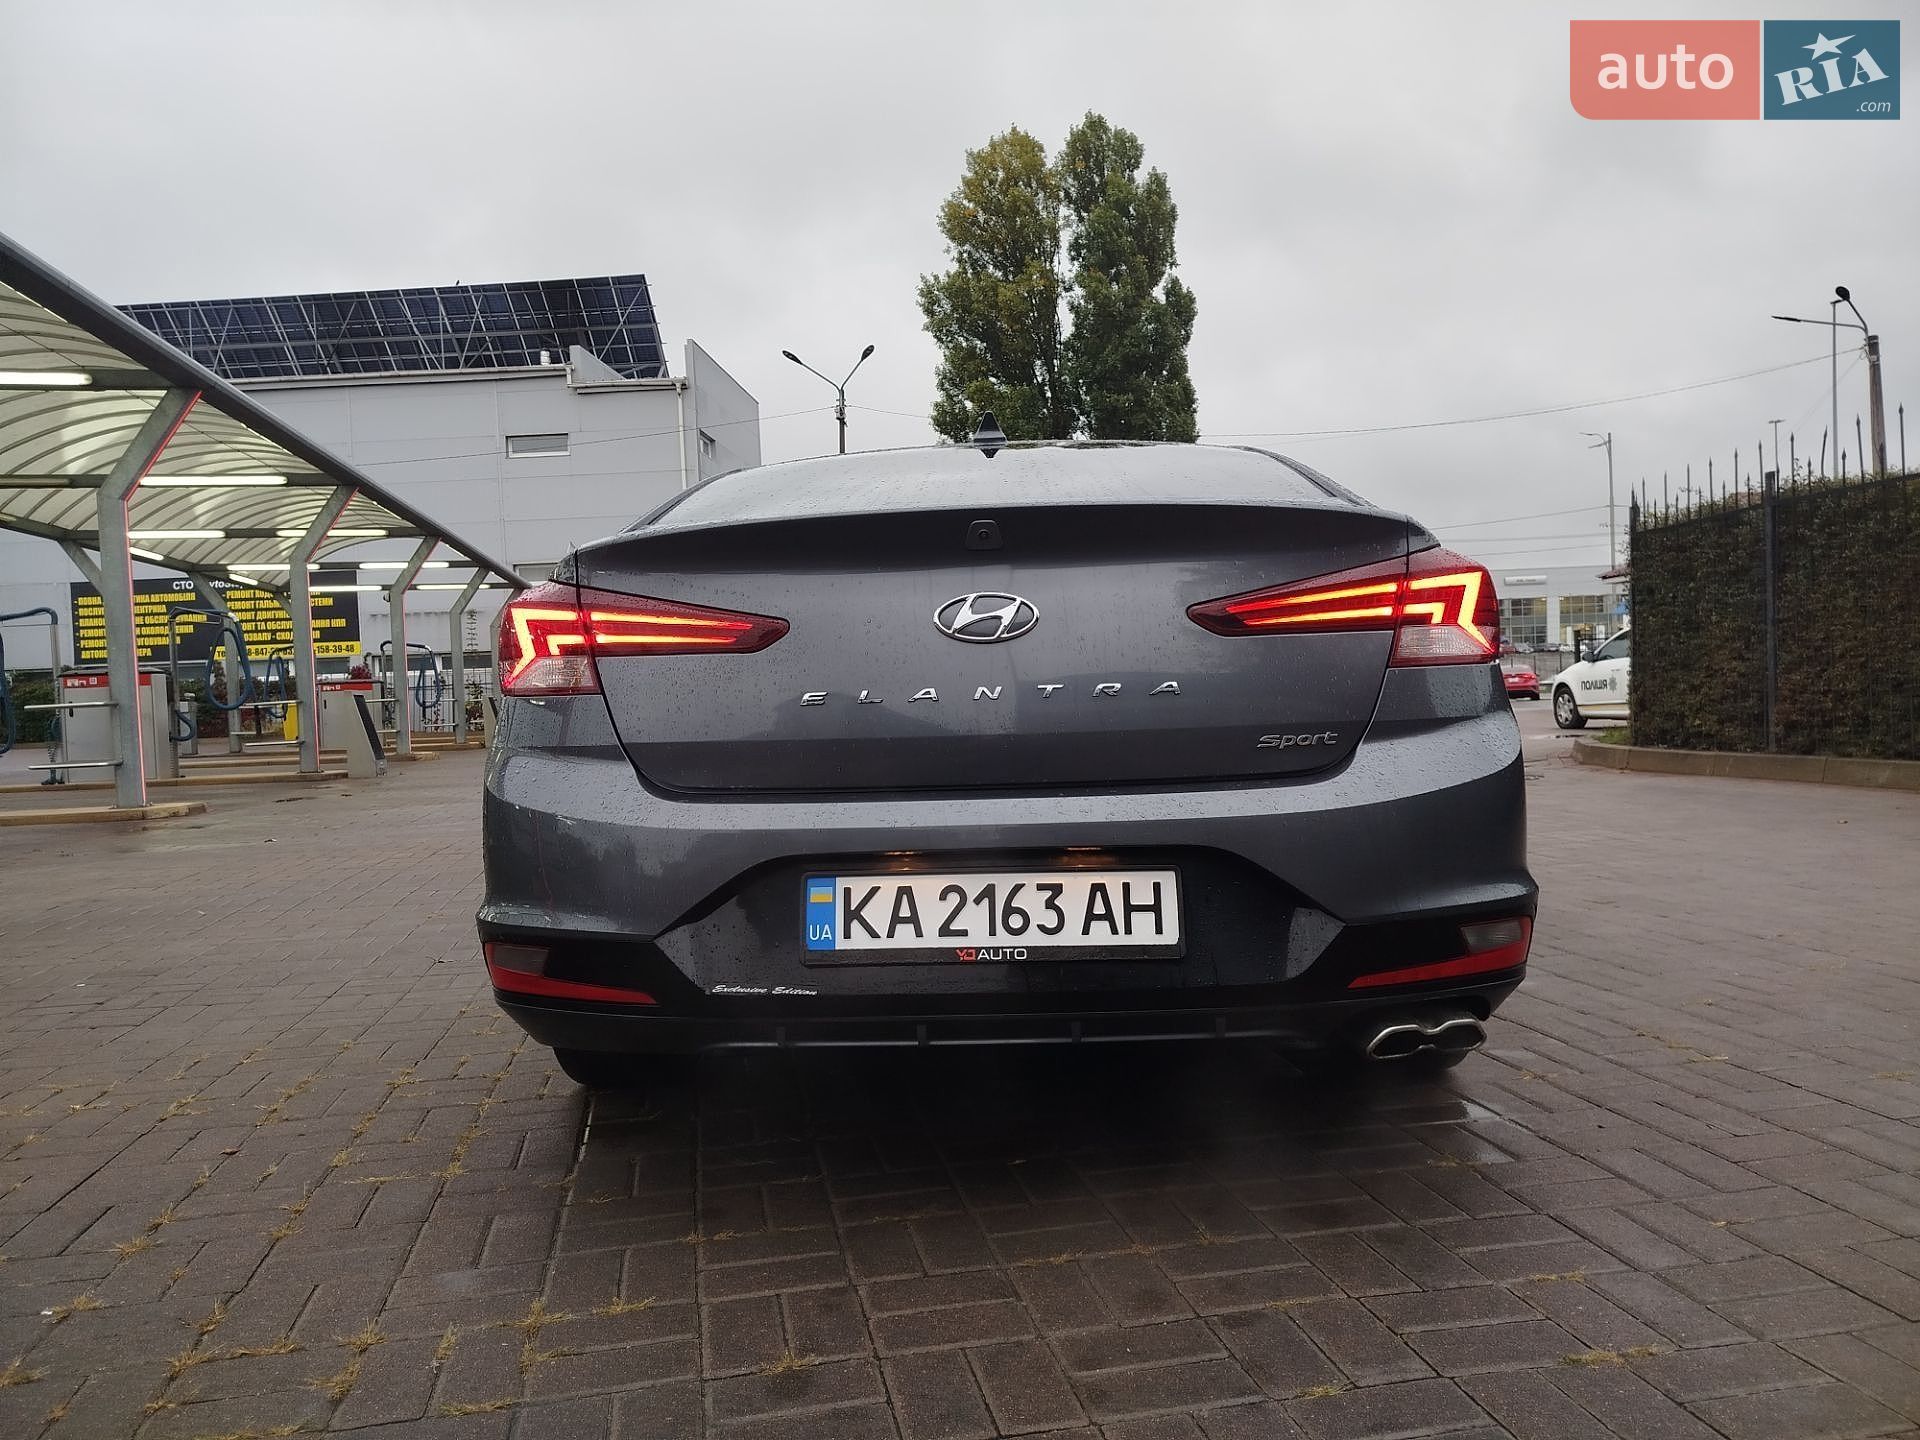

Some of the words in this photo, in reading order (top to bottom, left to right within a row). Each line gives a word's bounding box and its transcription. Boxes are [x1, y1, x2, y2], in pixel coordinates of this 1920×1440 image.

[172, 580, 194, 590] СТО
[800, 680, 1183, 706] ELANTRA
[1256, 731, 1339, 750] Sport
[842, 884, 924, 940] KA
[937, 881, 1066, 938] 2163
[1080, 880, 1164, 936] AH
[809, 923, 833, 941] UA
